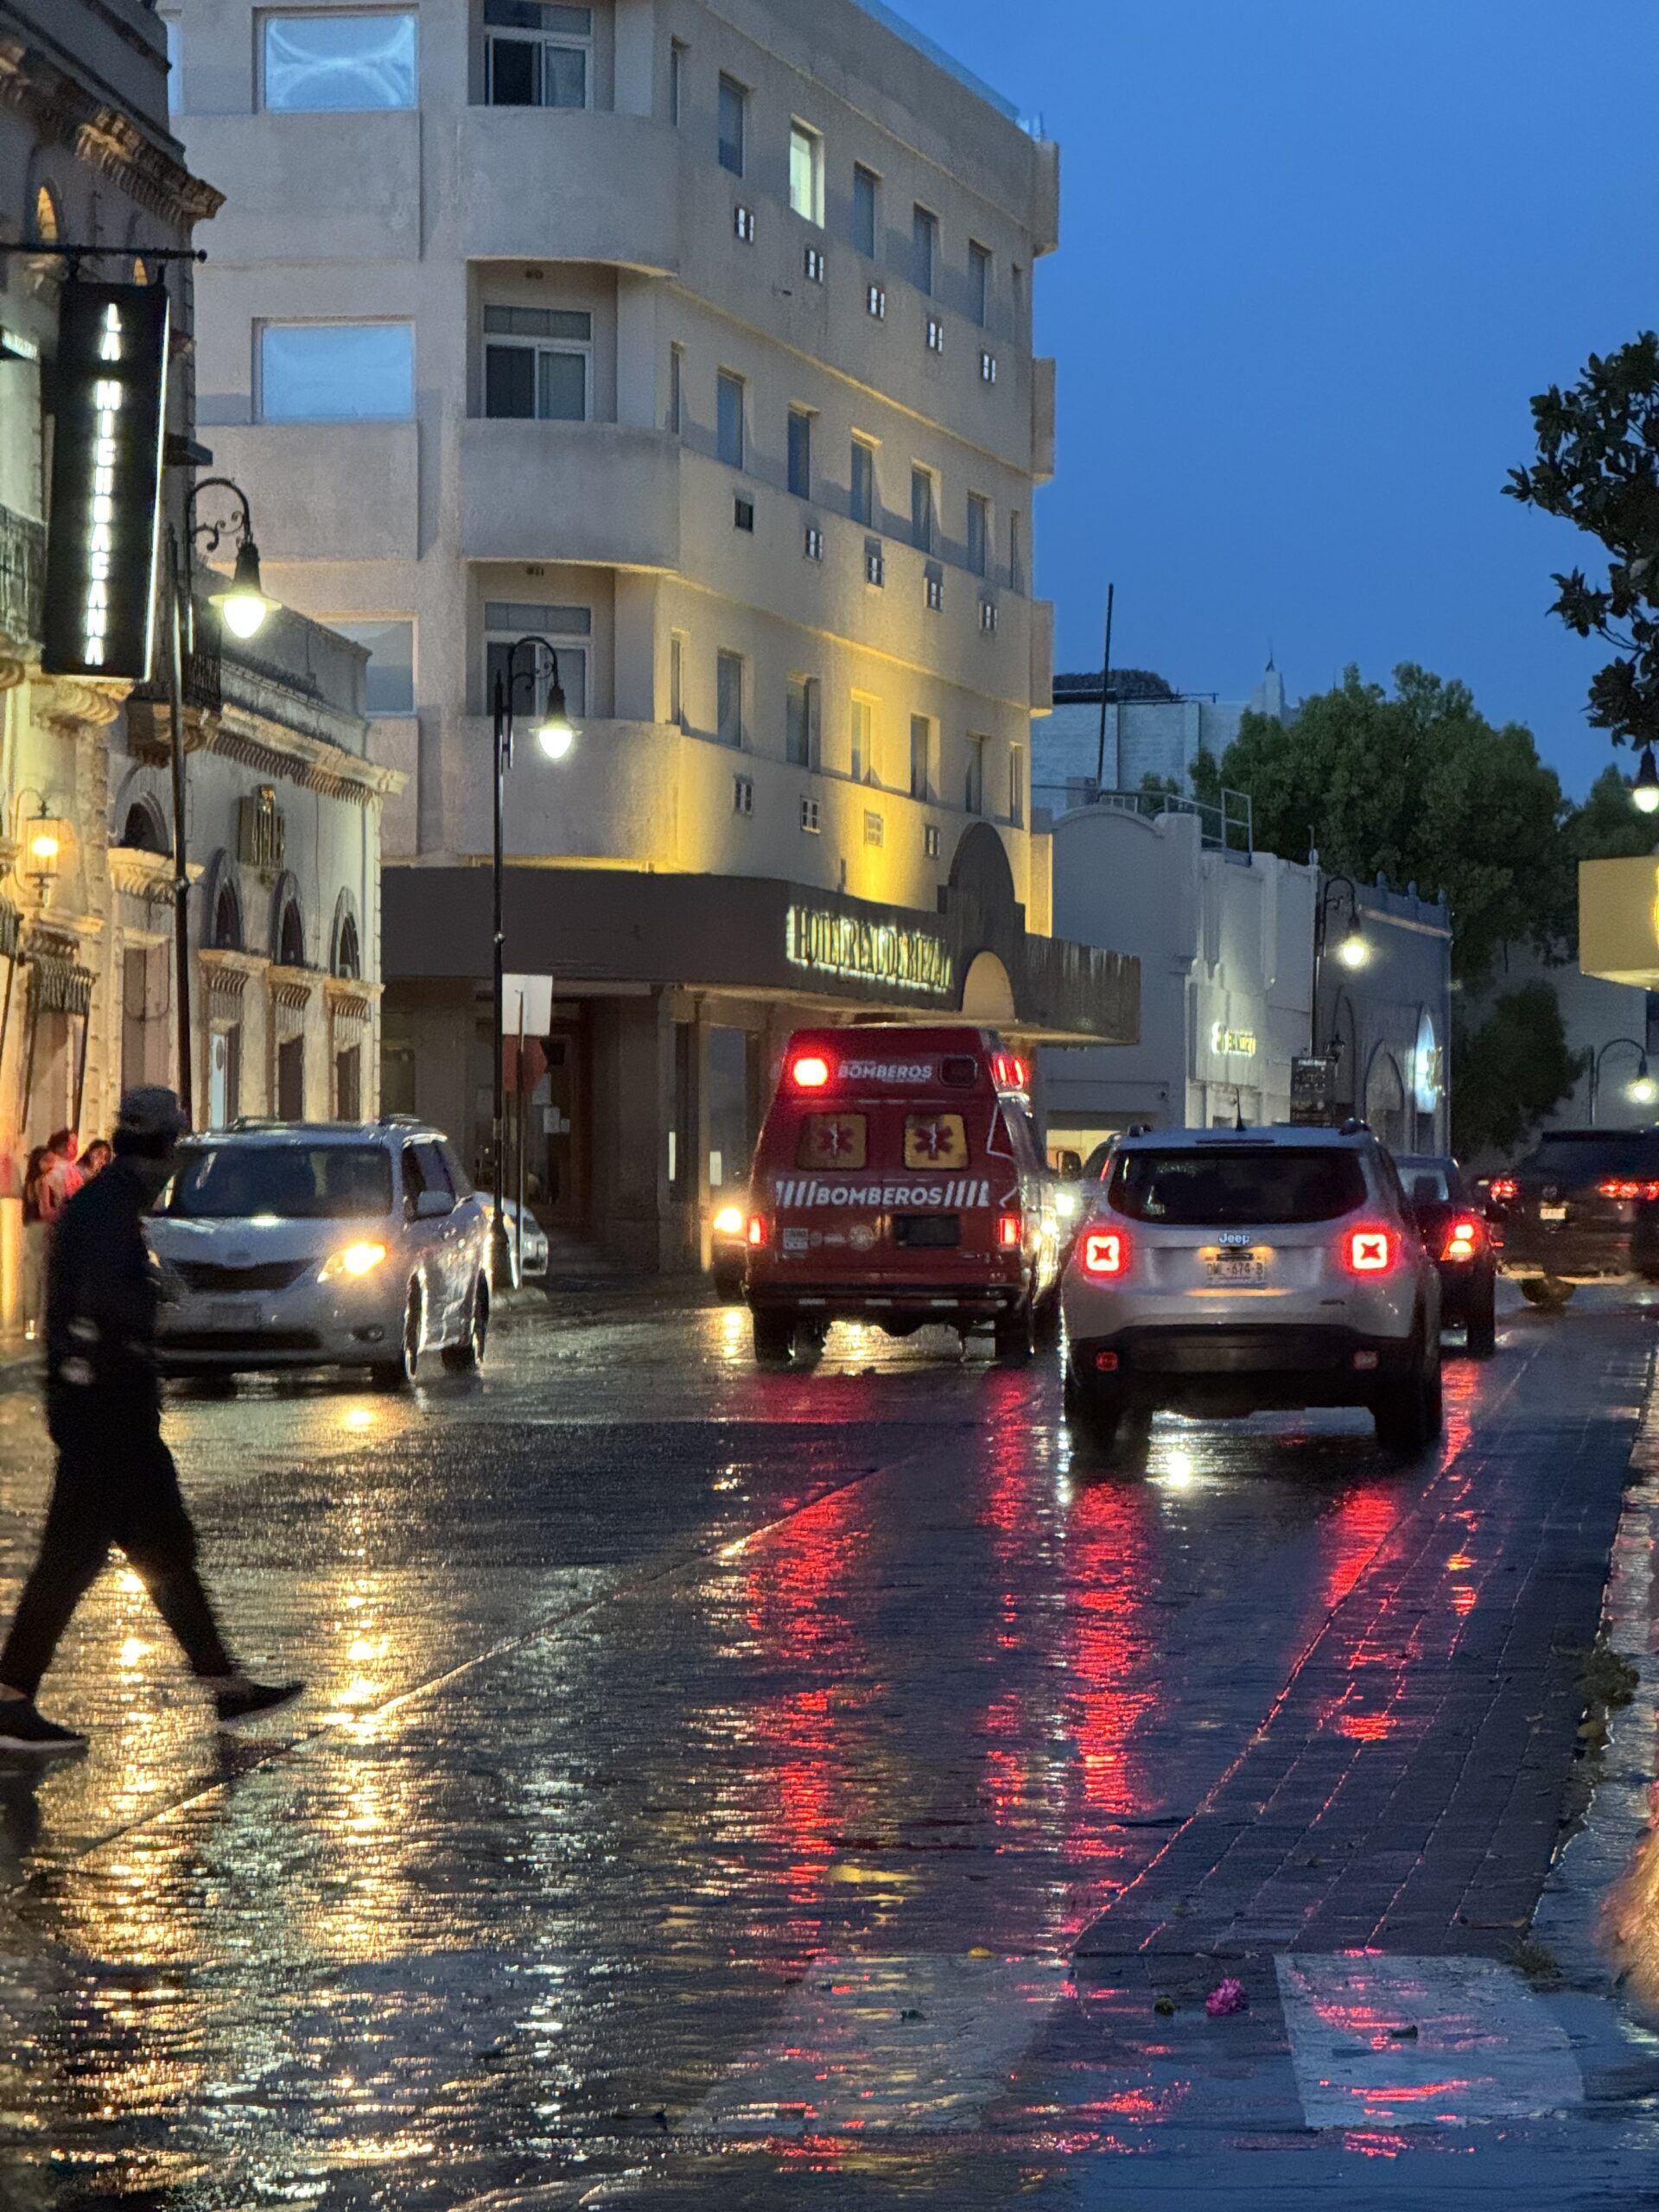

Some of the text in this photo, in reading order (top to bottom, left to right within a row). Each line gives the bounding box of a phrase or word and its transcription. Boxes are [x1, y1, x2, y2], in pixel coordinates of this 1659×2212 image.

[85, 302, 122, 665] LA MICHOACANA
[790, 906, 844, 969] HOTEL
[837, 1065, 932, 1078] BOMBEROS
[815, 1186, 942, 1206] BOMBEROS
[1218, 1233, 1250, 1244] Jeep
